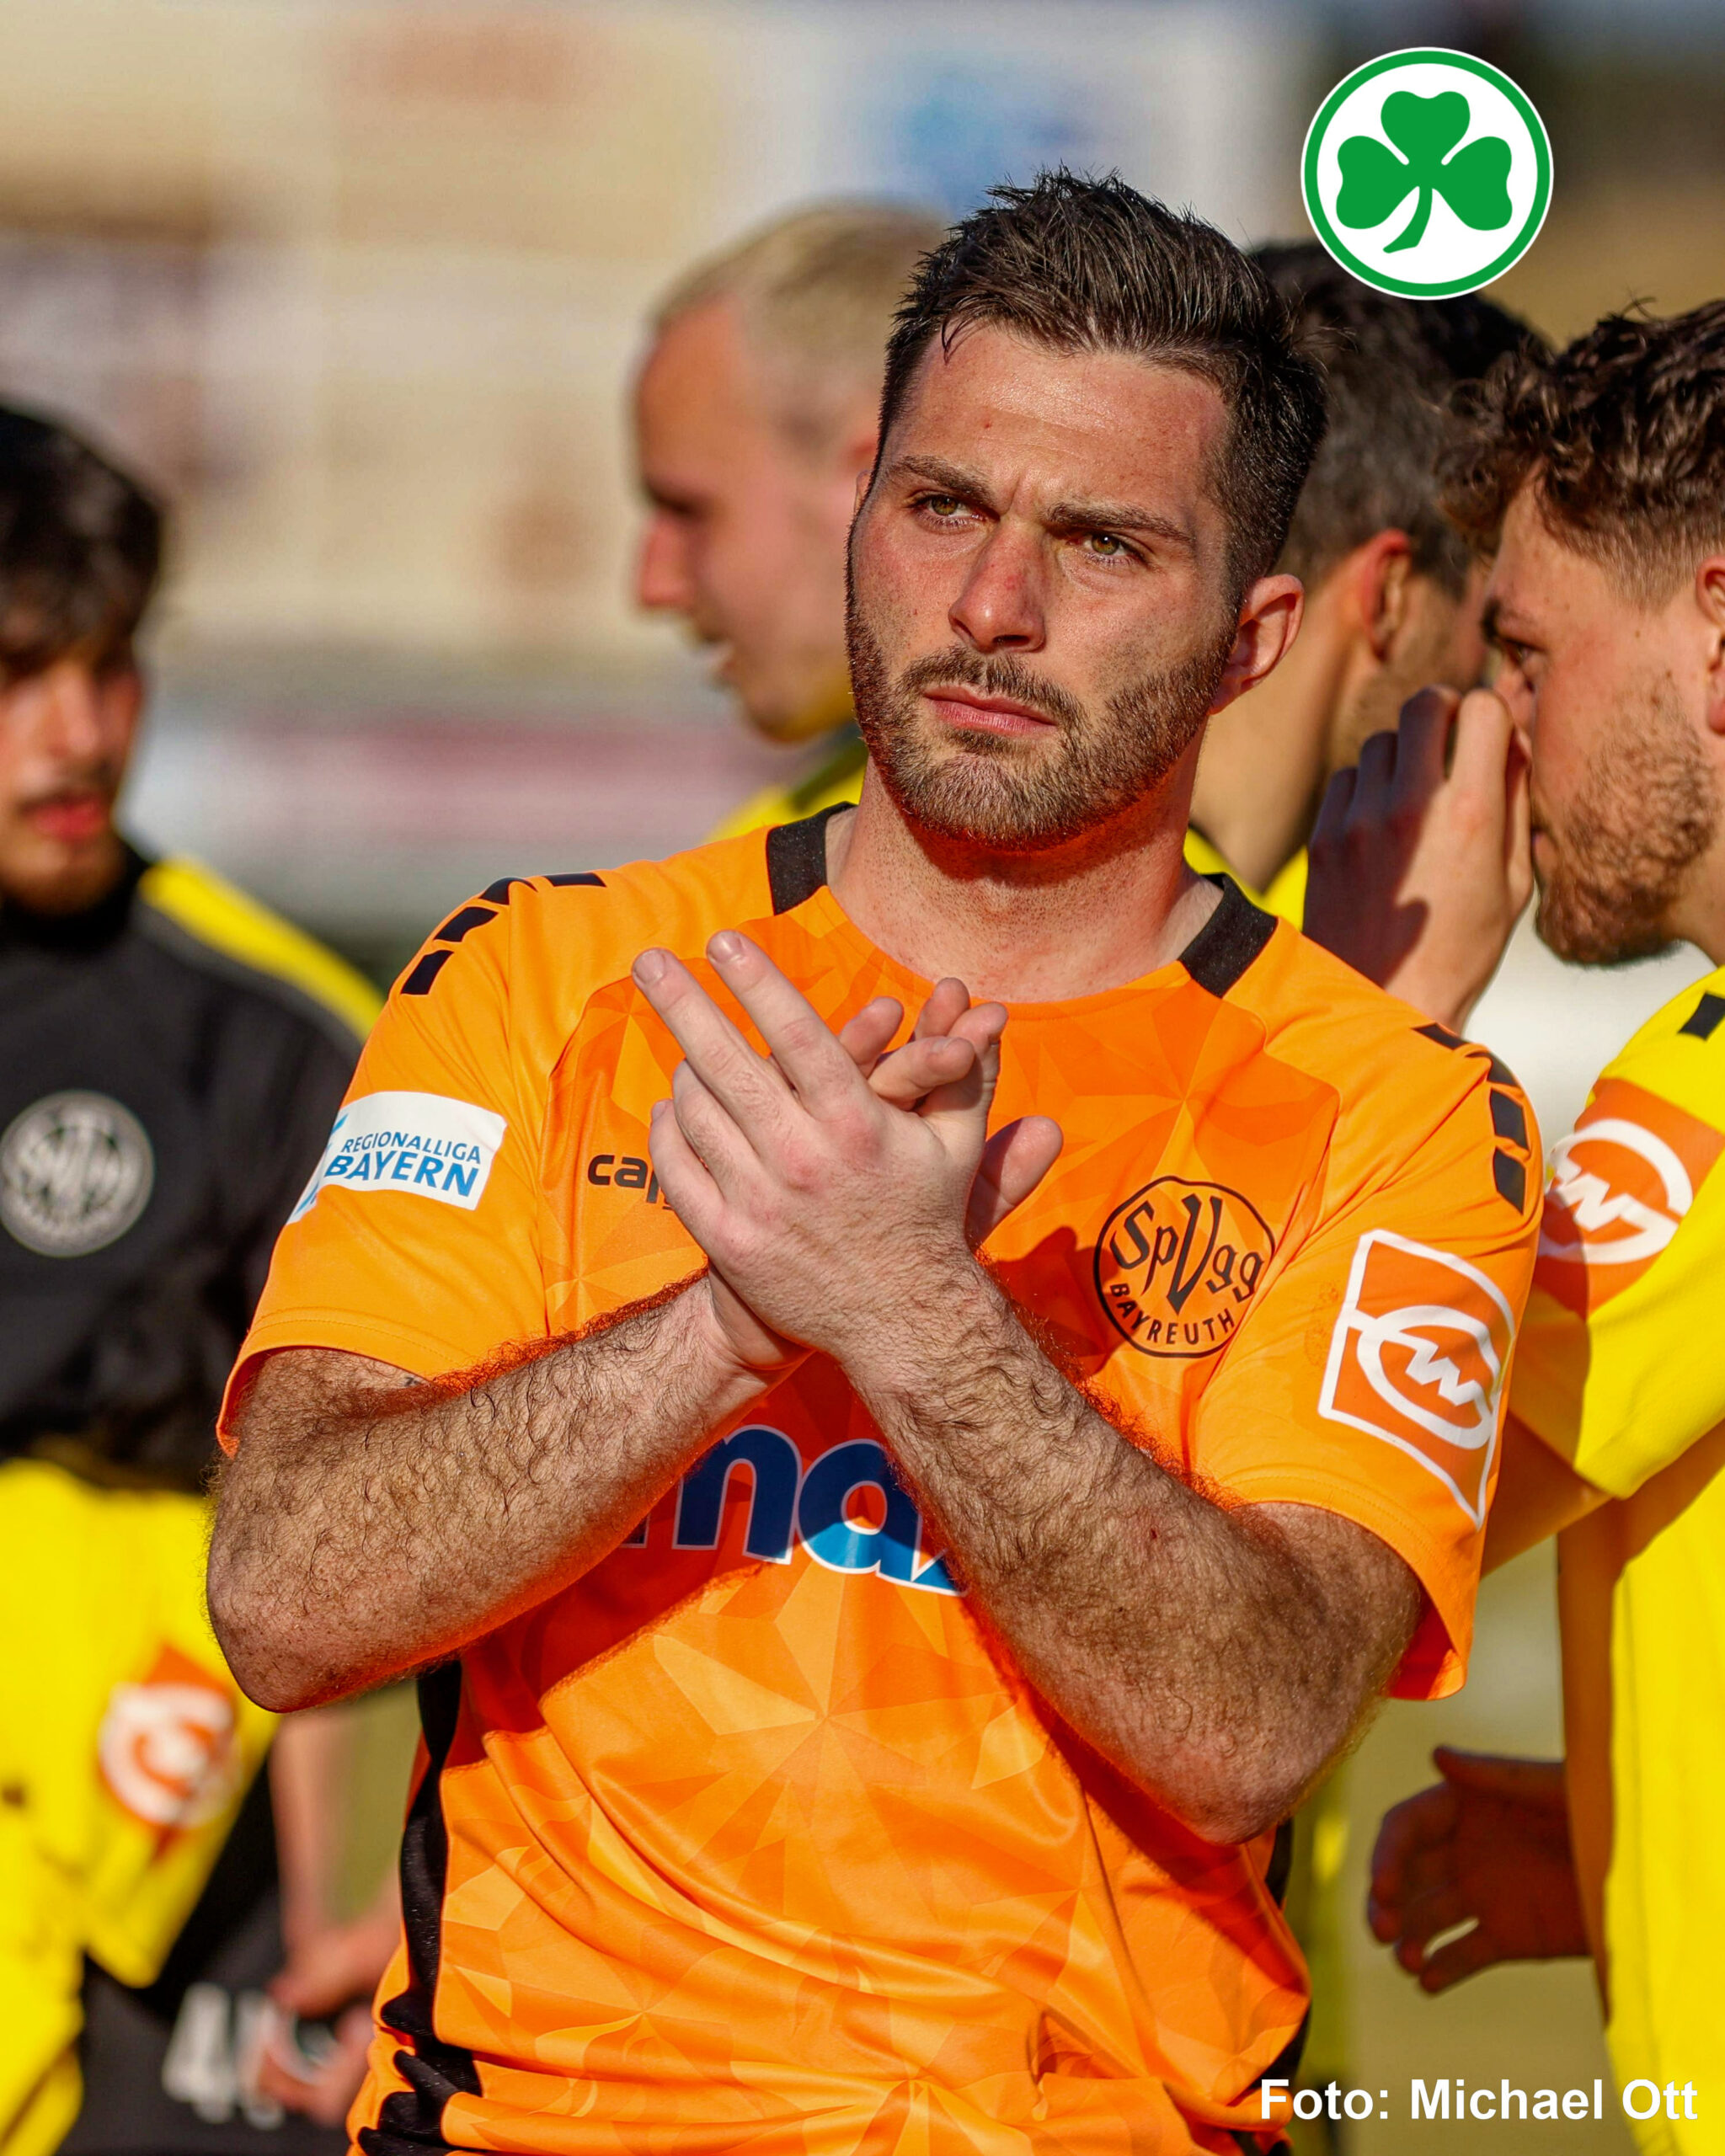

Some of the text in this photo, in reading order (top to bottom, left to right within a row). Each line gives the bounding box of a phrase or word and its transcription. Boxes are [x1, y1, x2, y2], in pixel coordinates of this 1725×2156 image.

[323, 1149, 479, 1198] BAYERN
[341, 1131, 481, 1165] REGIONALLIGA
[1108, 1193, 1264, 1315] SpVgg
[1109, 1283, 1235, 1345] BAYREUTH
